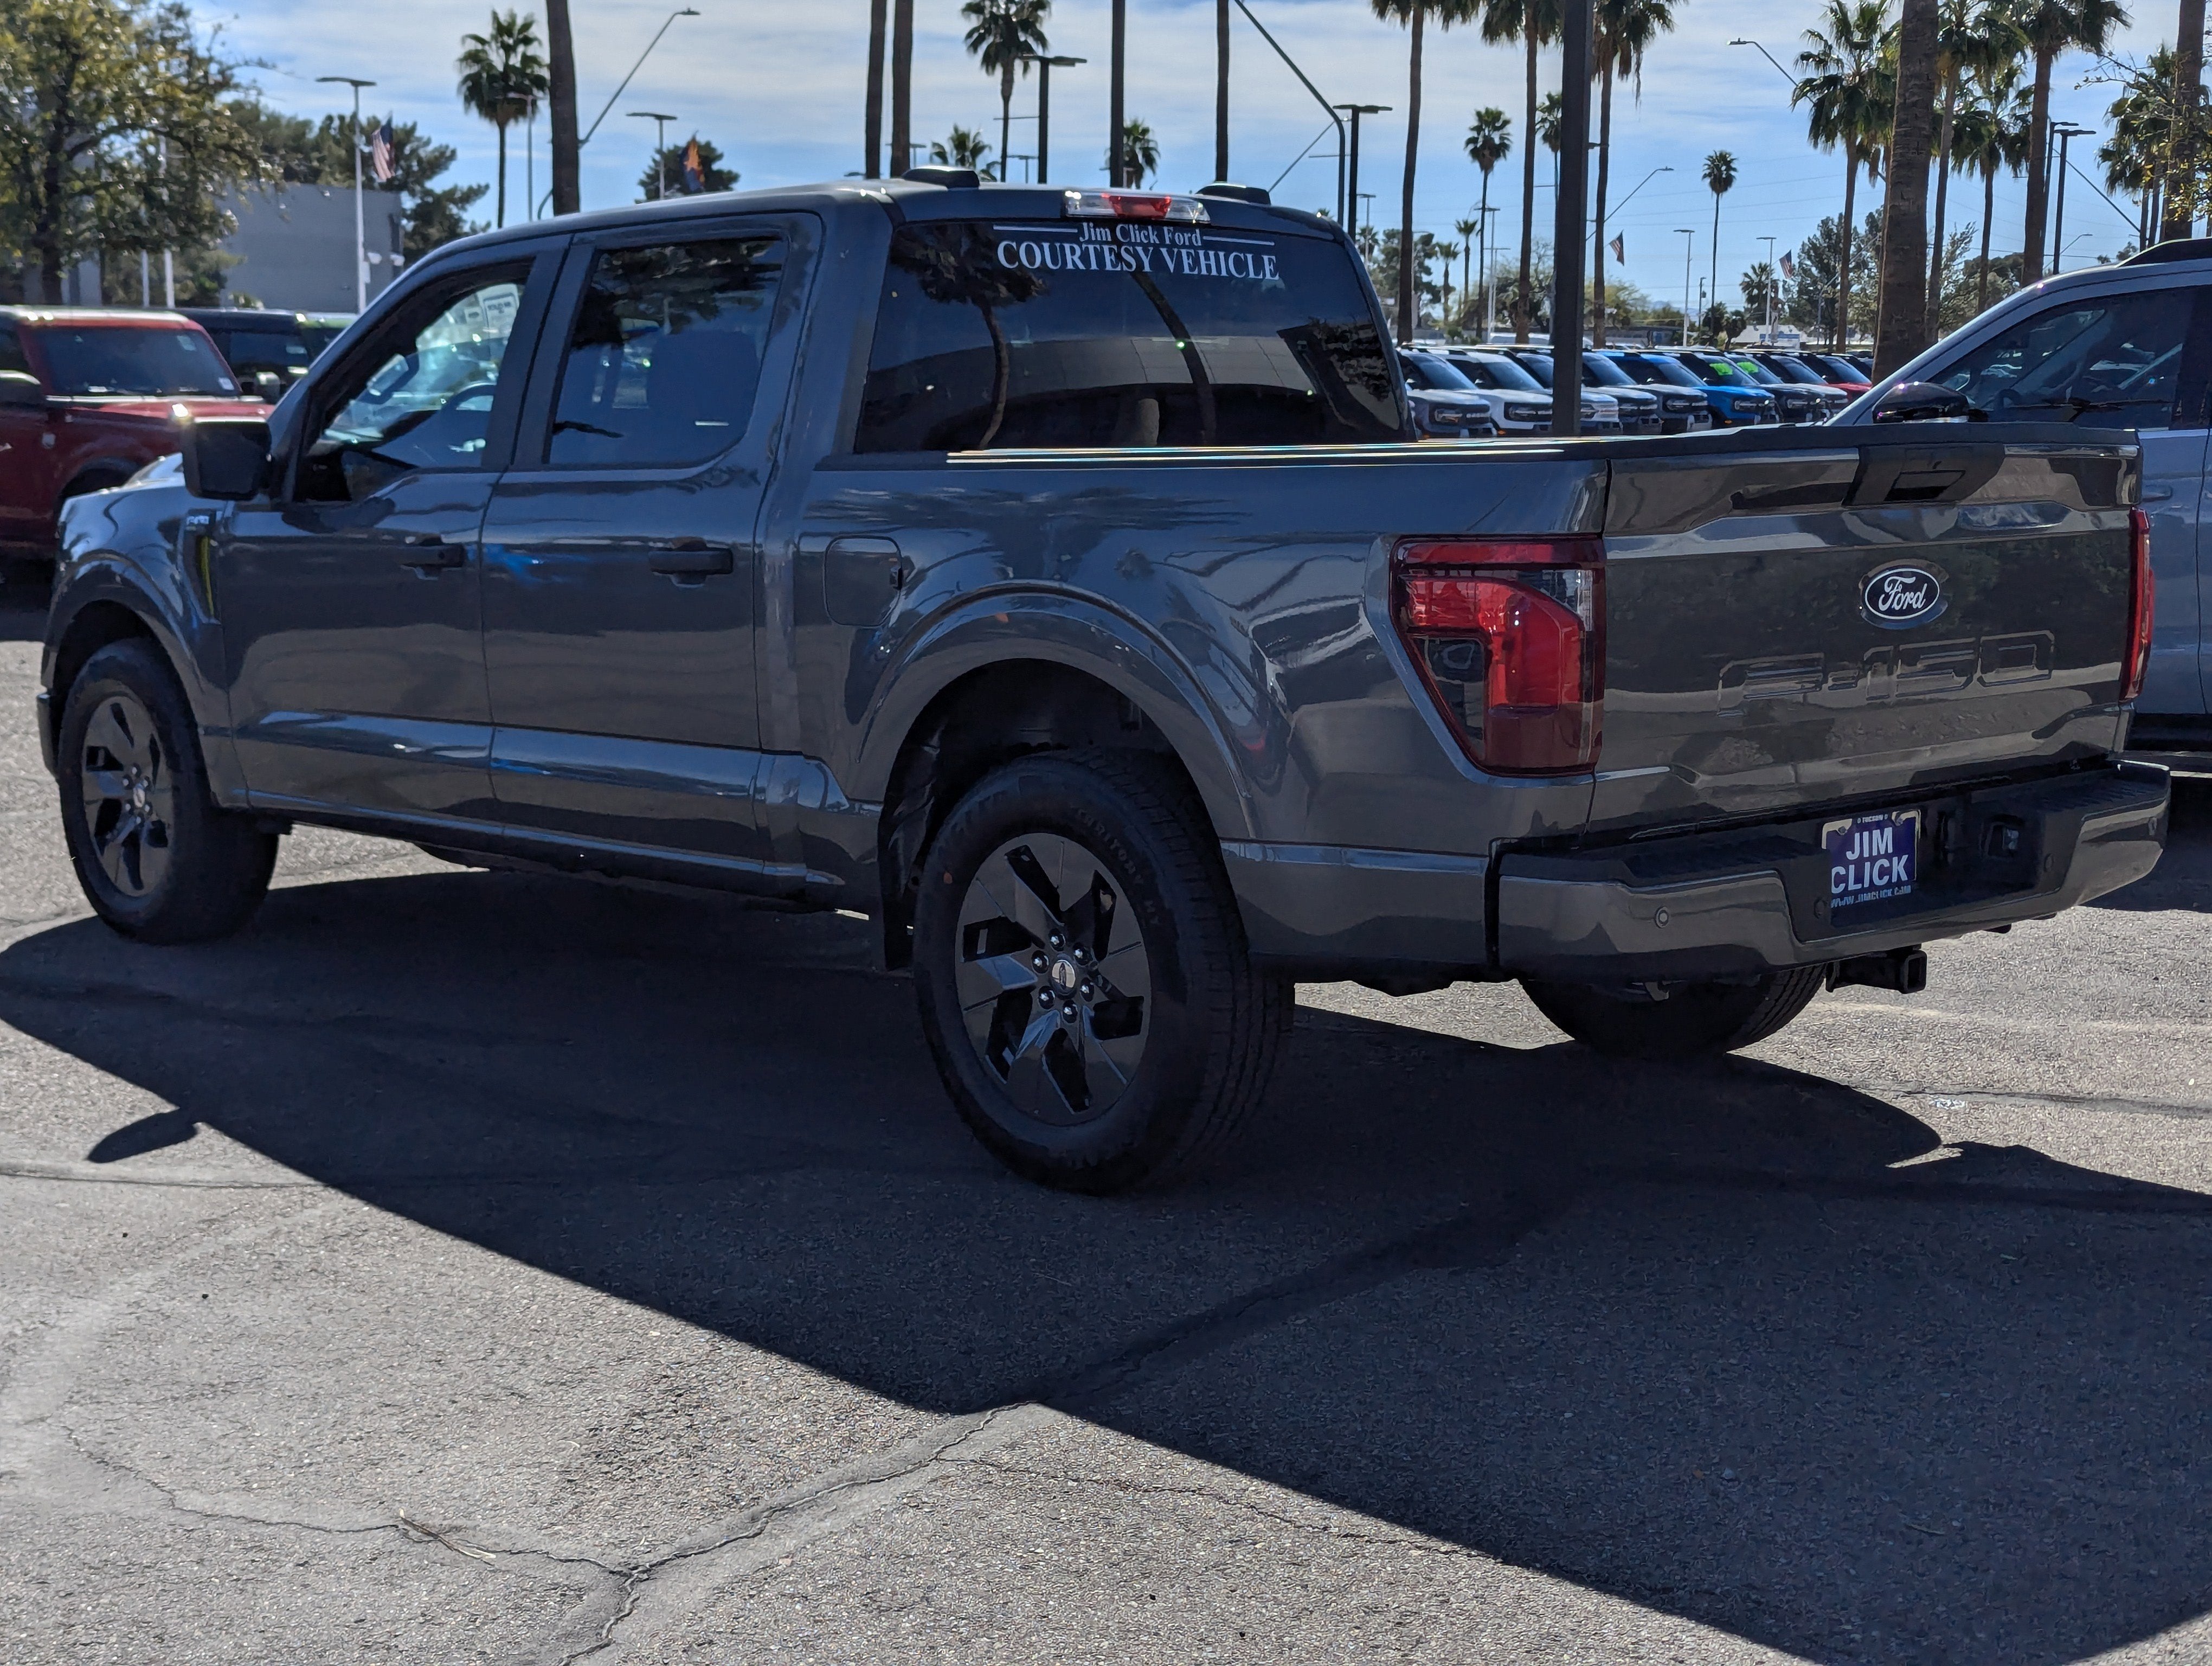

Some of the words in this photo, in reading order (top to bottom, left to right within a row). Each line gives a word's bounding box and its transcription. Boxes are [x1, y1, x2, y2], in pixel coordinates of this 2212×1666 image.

[1079, 222, 1112, 242] Jim
[1116, 223, 1160, 244] Click
[1163, 226, 1202, 246] Ford
[997, 241, 1153, 272] COURTESY
[1159, 247, 1279, 280] VEHICLE
[1878, 576, 1927, 611] Ford
[1717, 629, 2055, 717] F-150
[1846, 826, 1893, 860] JIM
[1831, 855, 1909, 894] CLICK
